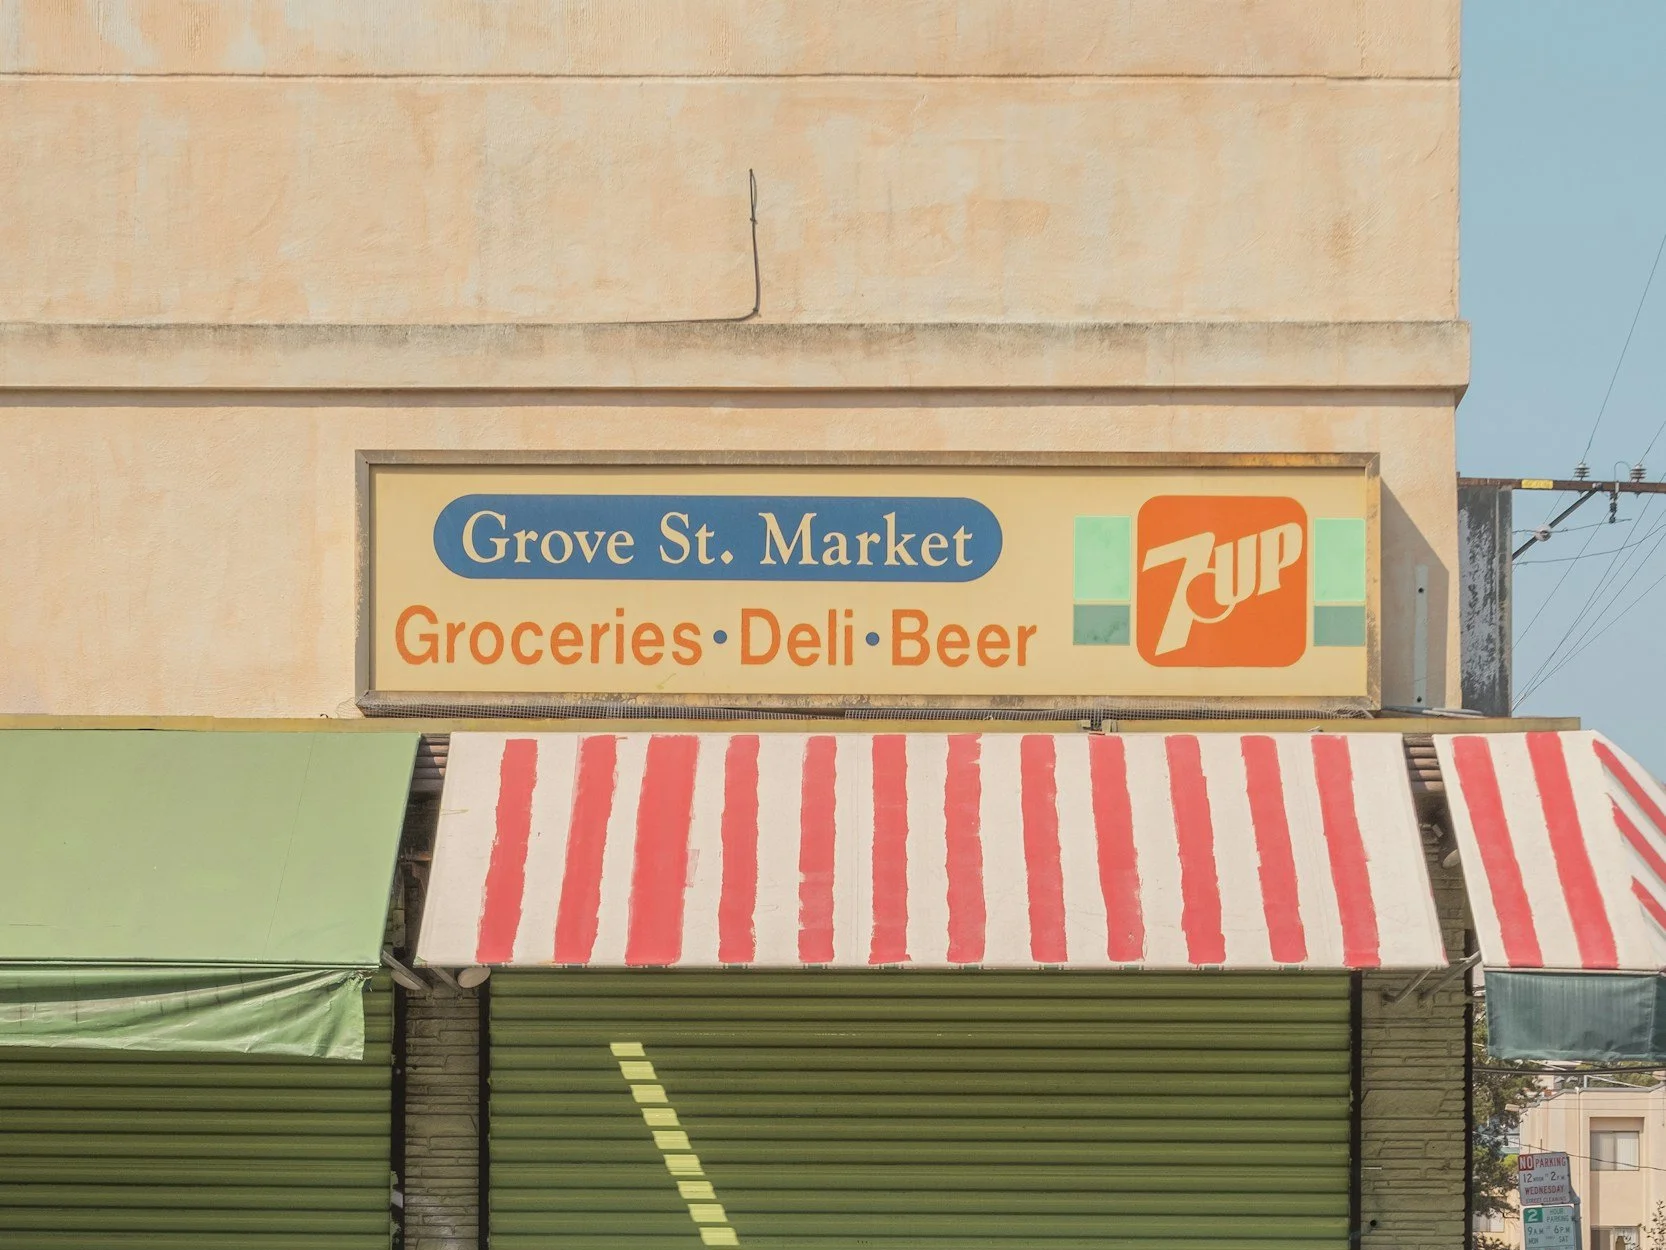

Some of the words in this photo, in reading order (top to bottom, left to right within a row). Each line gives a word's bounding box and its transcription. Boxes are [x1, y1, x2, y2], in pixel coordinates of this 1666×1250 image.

[461, 509, 635, 565] Grove
[659, 511, 735, 565] St.
[758, 512, 973, 567] Market
[395, 604, 703, 666] Groceries
[740, 607, 854, 667] Deli
[891, 608, 1038, 668] Beer
[1520, 1155, 1533, 1170] NO
[1535, 1156, 1566, 1168] PARKING
[1524, 1185, 1564, 1196] WEDNESDAY
[1527, 1208, 1539, 1222] 2
[1546, 1214, 1569, 1223] PARKING
